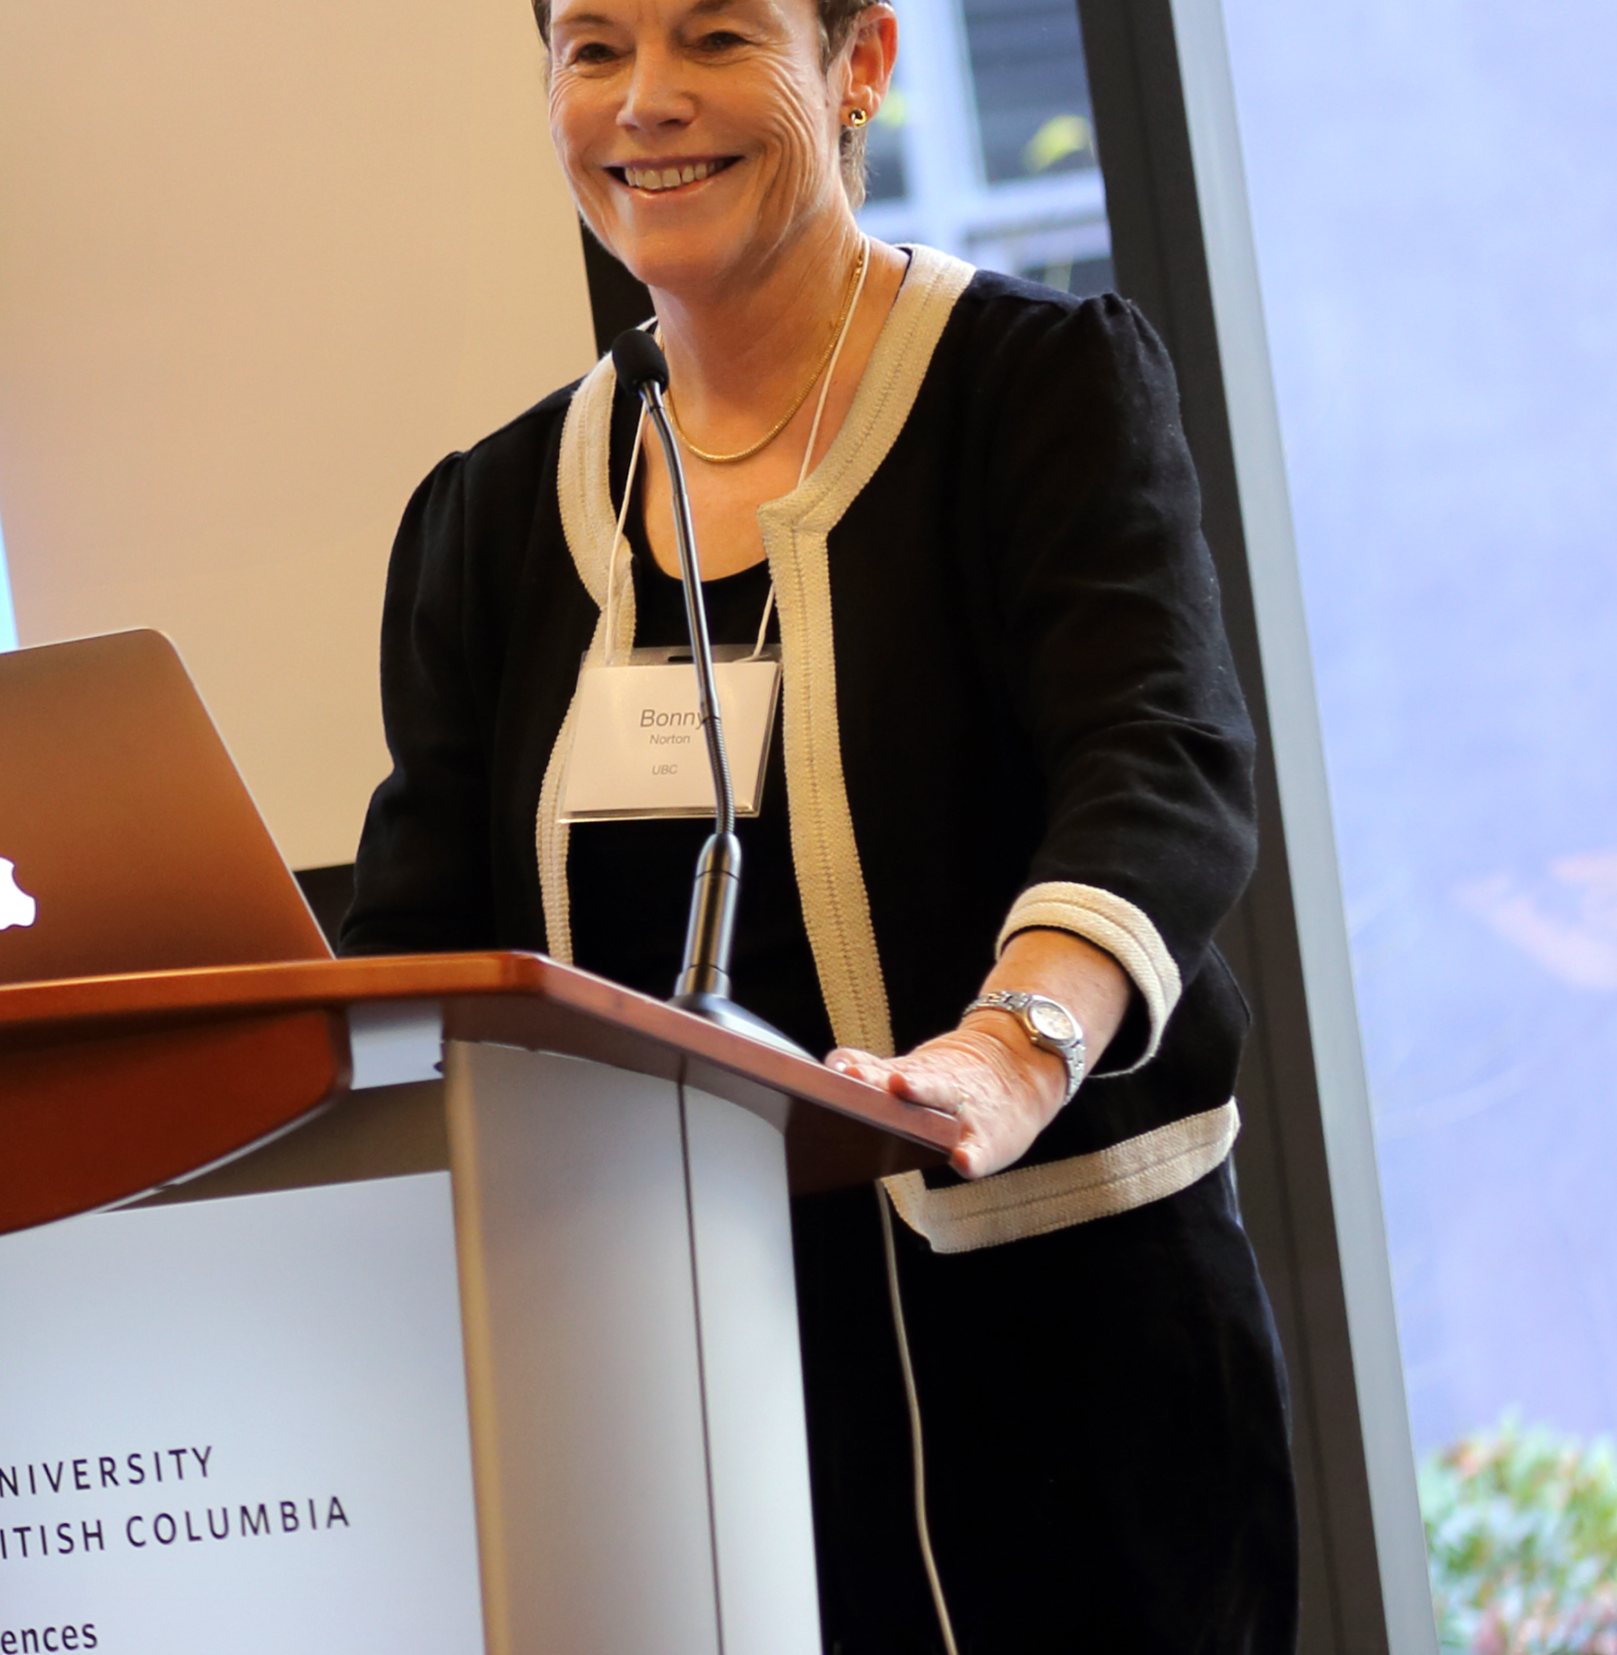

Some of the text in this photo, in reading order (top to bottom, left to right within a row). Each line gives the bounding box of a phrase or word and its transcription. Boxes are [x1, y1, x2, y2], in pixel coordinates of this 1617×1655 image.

[649, 733, 691, 745] Norton
[651, 763, 679, 776] UBC
[124, 1495, 351, 1549] COLUMBIA
